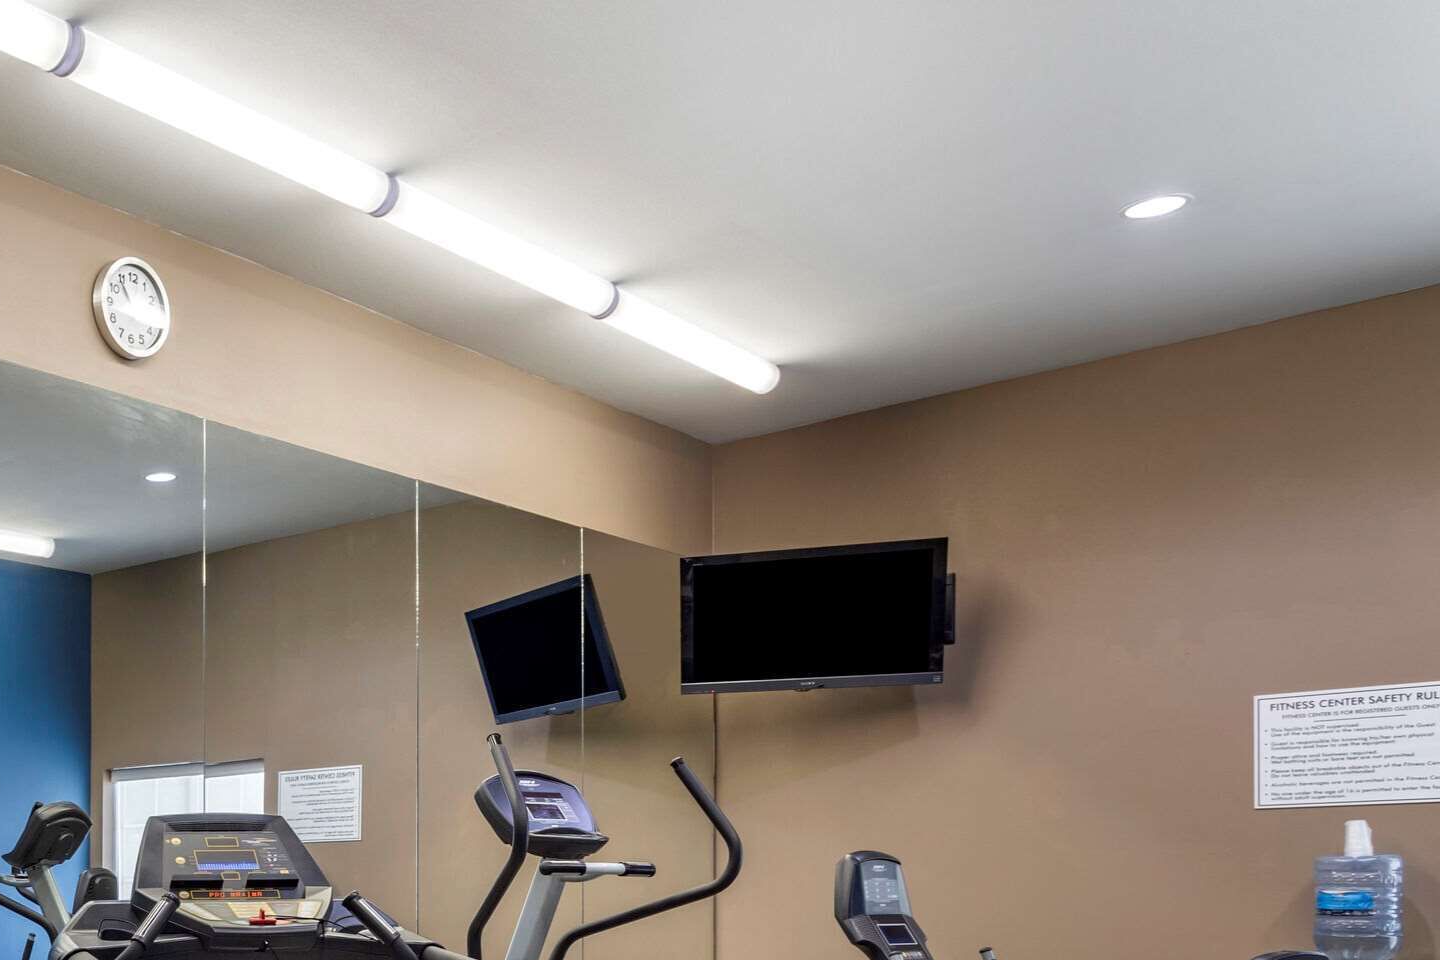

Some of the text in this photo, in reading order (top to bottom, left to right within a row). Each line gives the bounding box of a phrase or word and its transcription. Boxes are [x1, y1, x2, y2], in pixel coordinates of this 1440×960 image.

[128, 272, 138, 285] 12
[109, 282, 120, 294] 10
[110, 312, 117, 323] 8
[118, 327, 125, 339] 7
[128, 334, 135, 344] 6
[138, 334, 145, 345] 5
[1270, 690, 1440, 711] FITNESS CENTER SAFETY RUL
